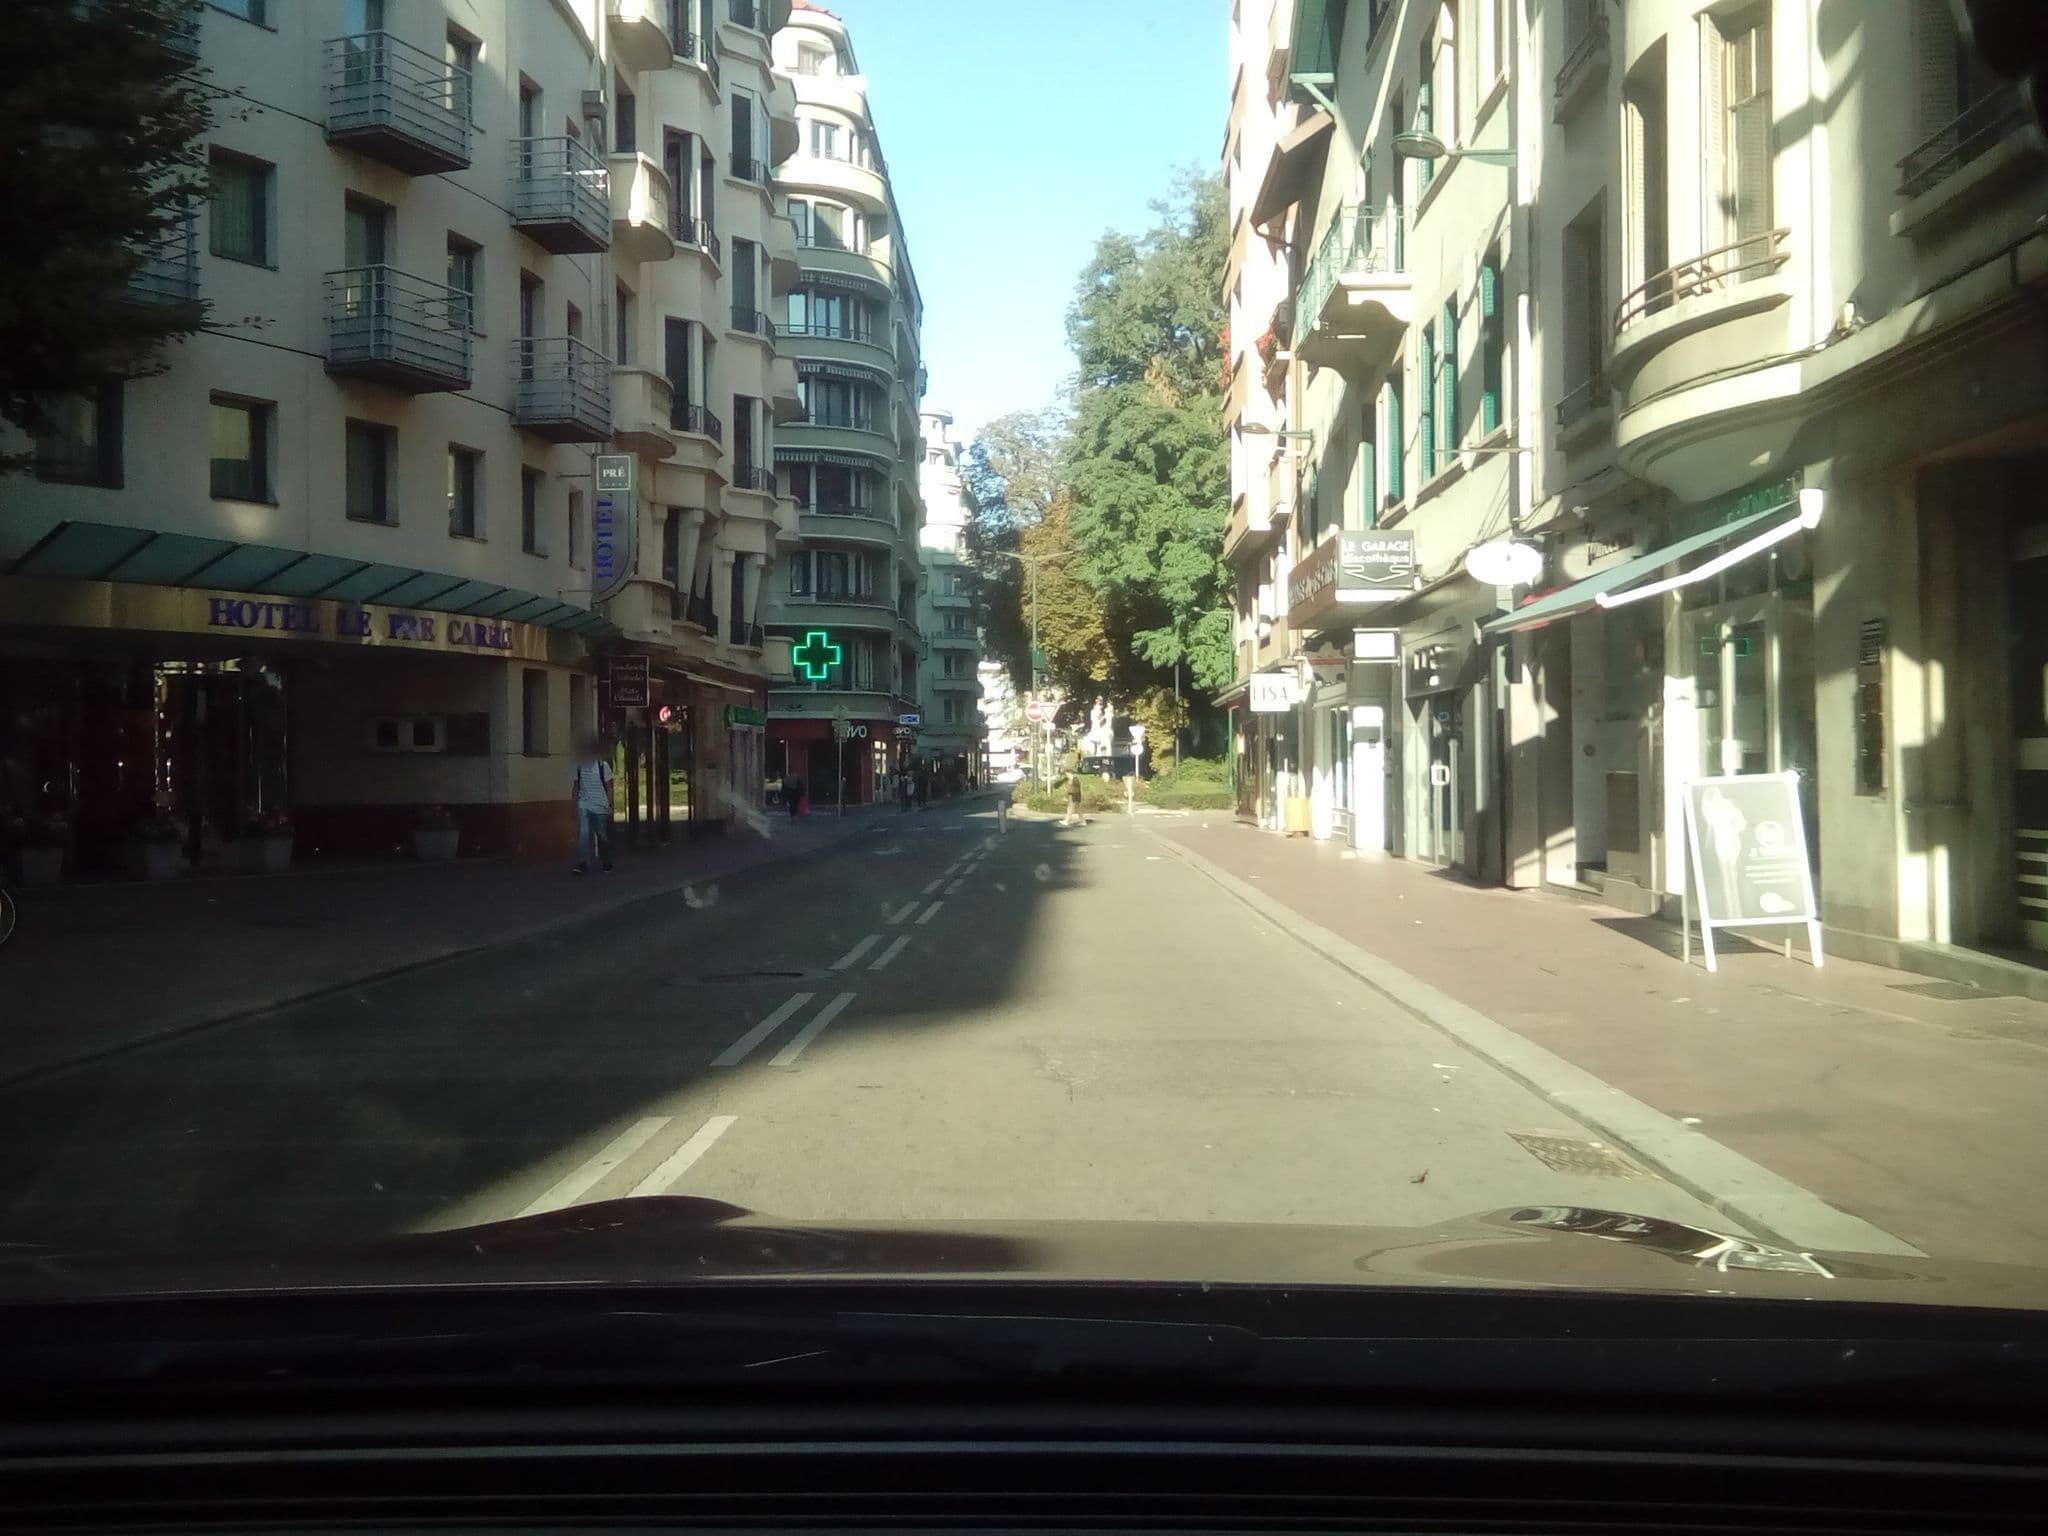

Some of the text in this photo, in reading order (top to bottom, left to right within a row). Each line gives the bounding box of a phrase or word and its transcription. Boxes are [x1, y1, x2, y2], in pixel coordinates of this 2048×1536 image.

[602, 465, 625, 478] PRÉ
[596, 492, 613, 578] HOTEL
[1361, 540, 1410, 552] GARAGE
[208, 598, 320, 633] HOTEL
[335, 606, 372, 637] LE
